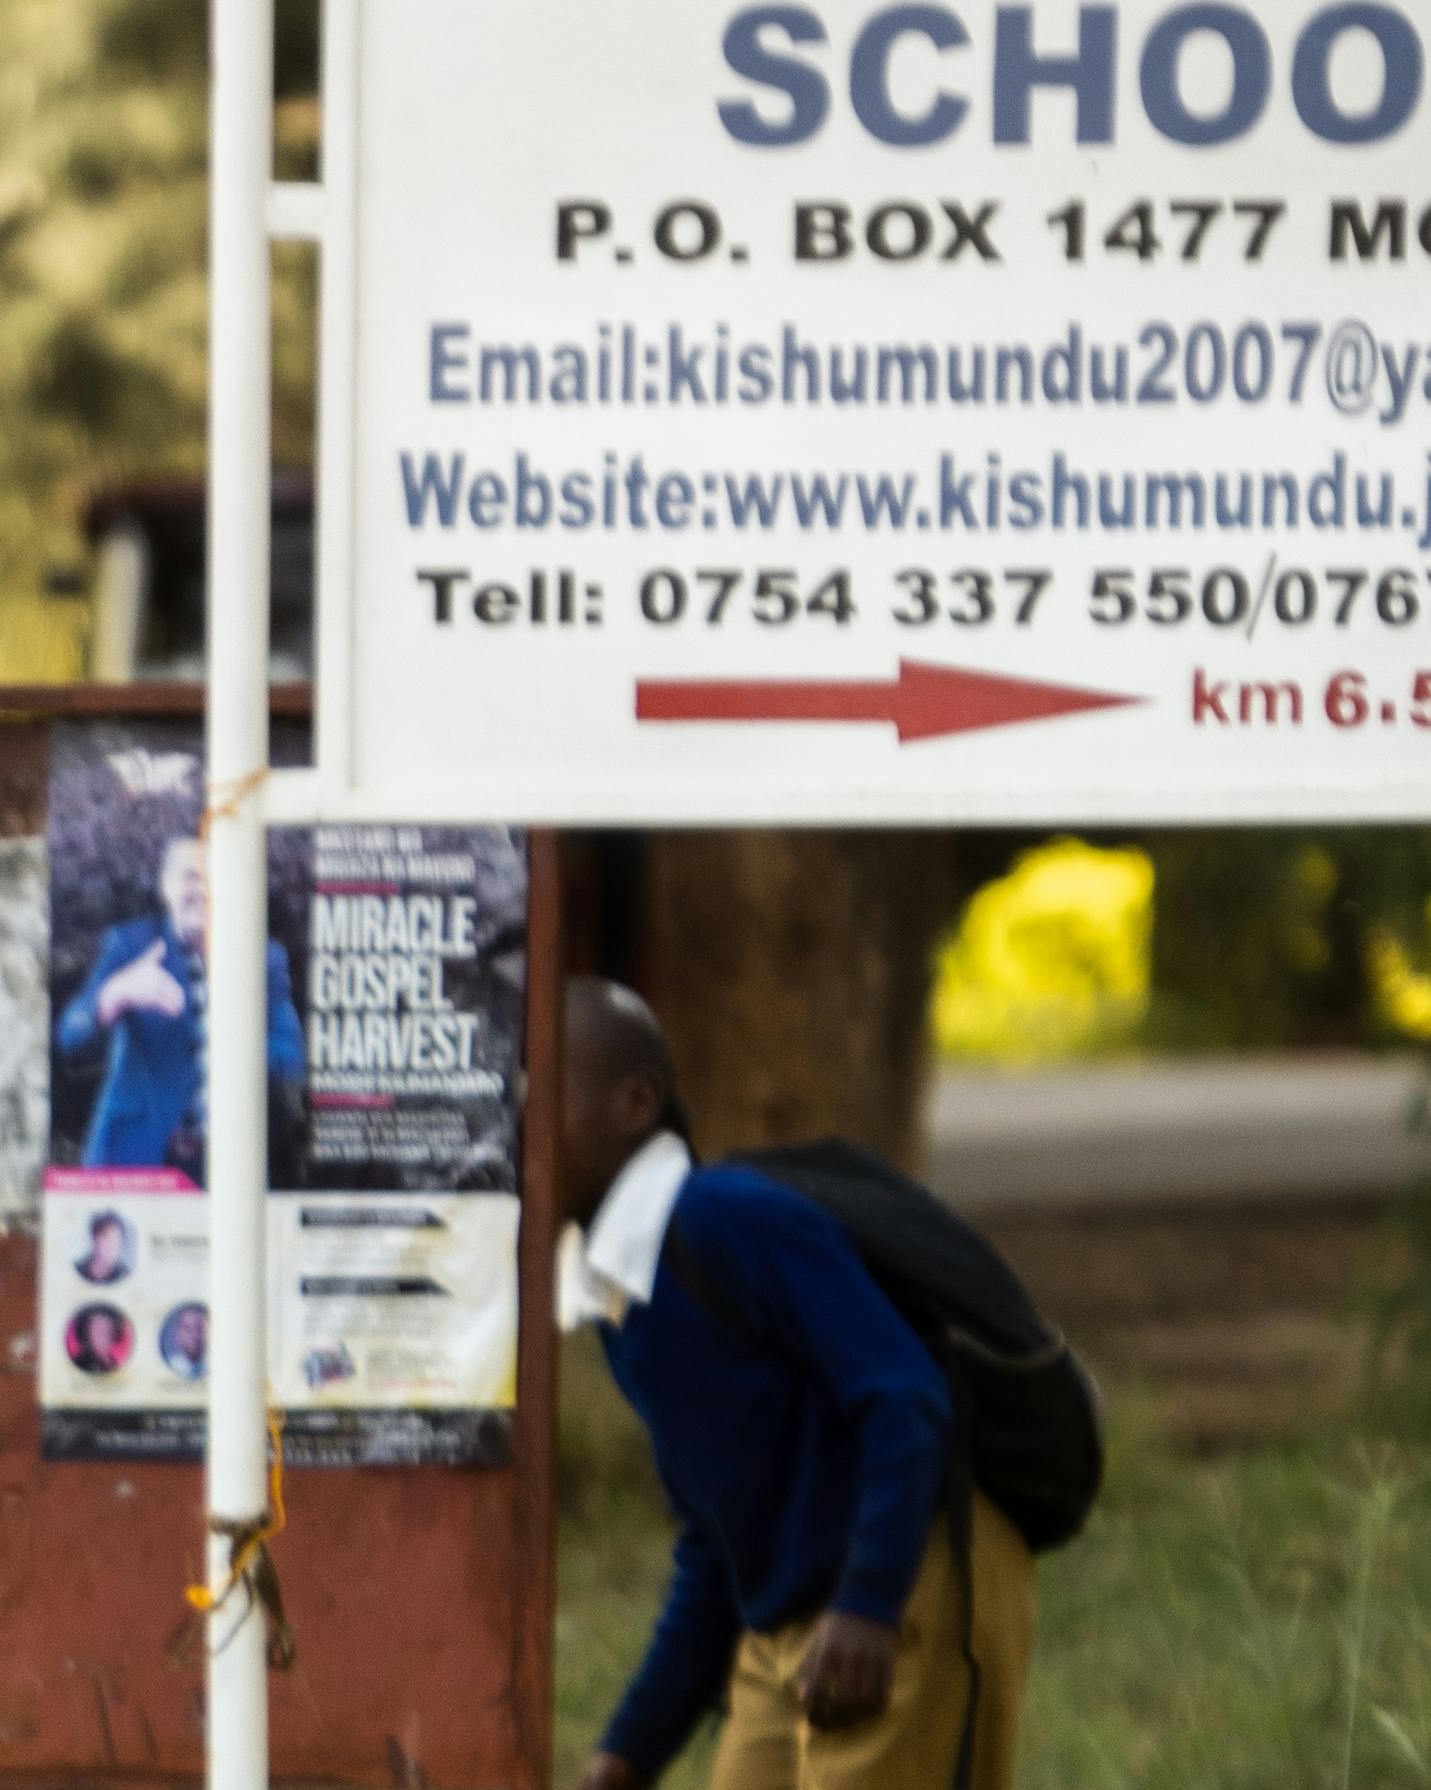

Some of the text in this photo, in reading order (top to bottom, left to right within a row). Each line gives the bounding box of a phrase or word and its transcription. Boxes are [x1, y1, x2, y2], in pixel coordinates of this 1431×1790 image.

[716, 0, 1425, 148] SCHOO
[555, 197, 1431, 264] P.O. BOX 1477 M
[427, 318, 1431, 424] Email:kishumundu2007@y
[415, 552, 1431, 640] Tell: 0754 337 550/076
[1191, 667, 1304, 726] km
[311, 896, 477, 958] MIRACLE
[311, 954, 454, 1012] GOSPEL
[310, 1012, 479, 1070] HARVEST
